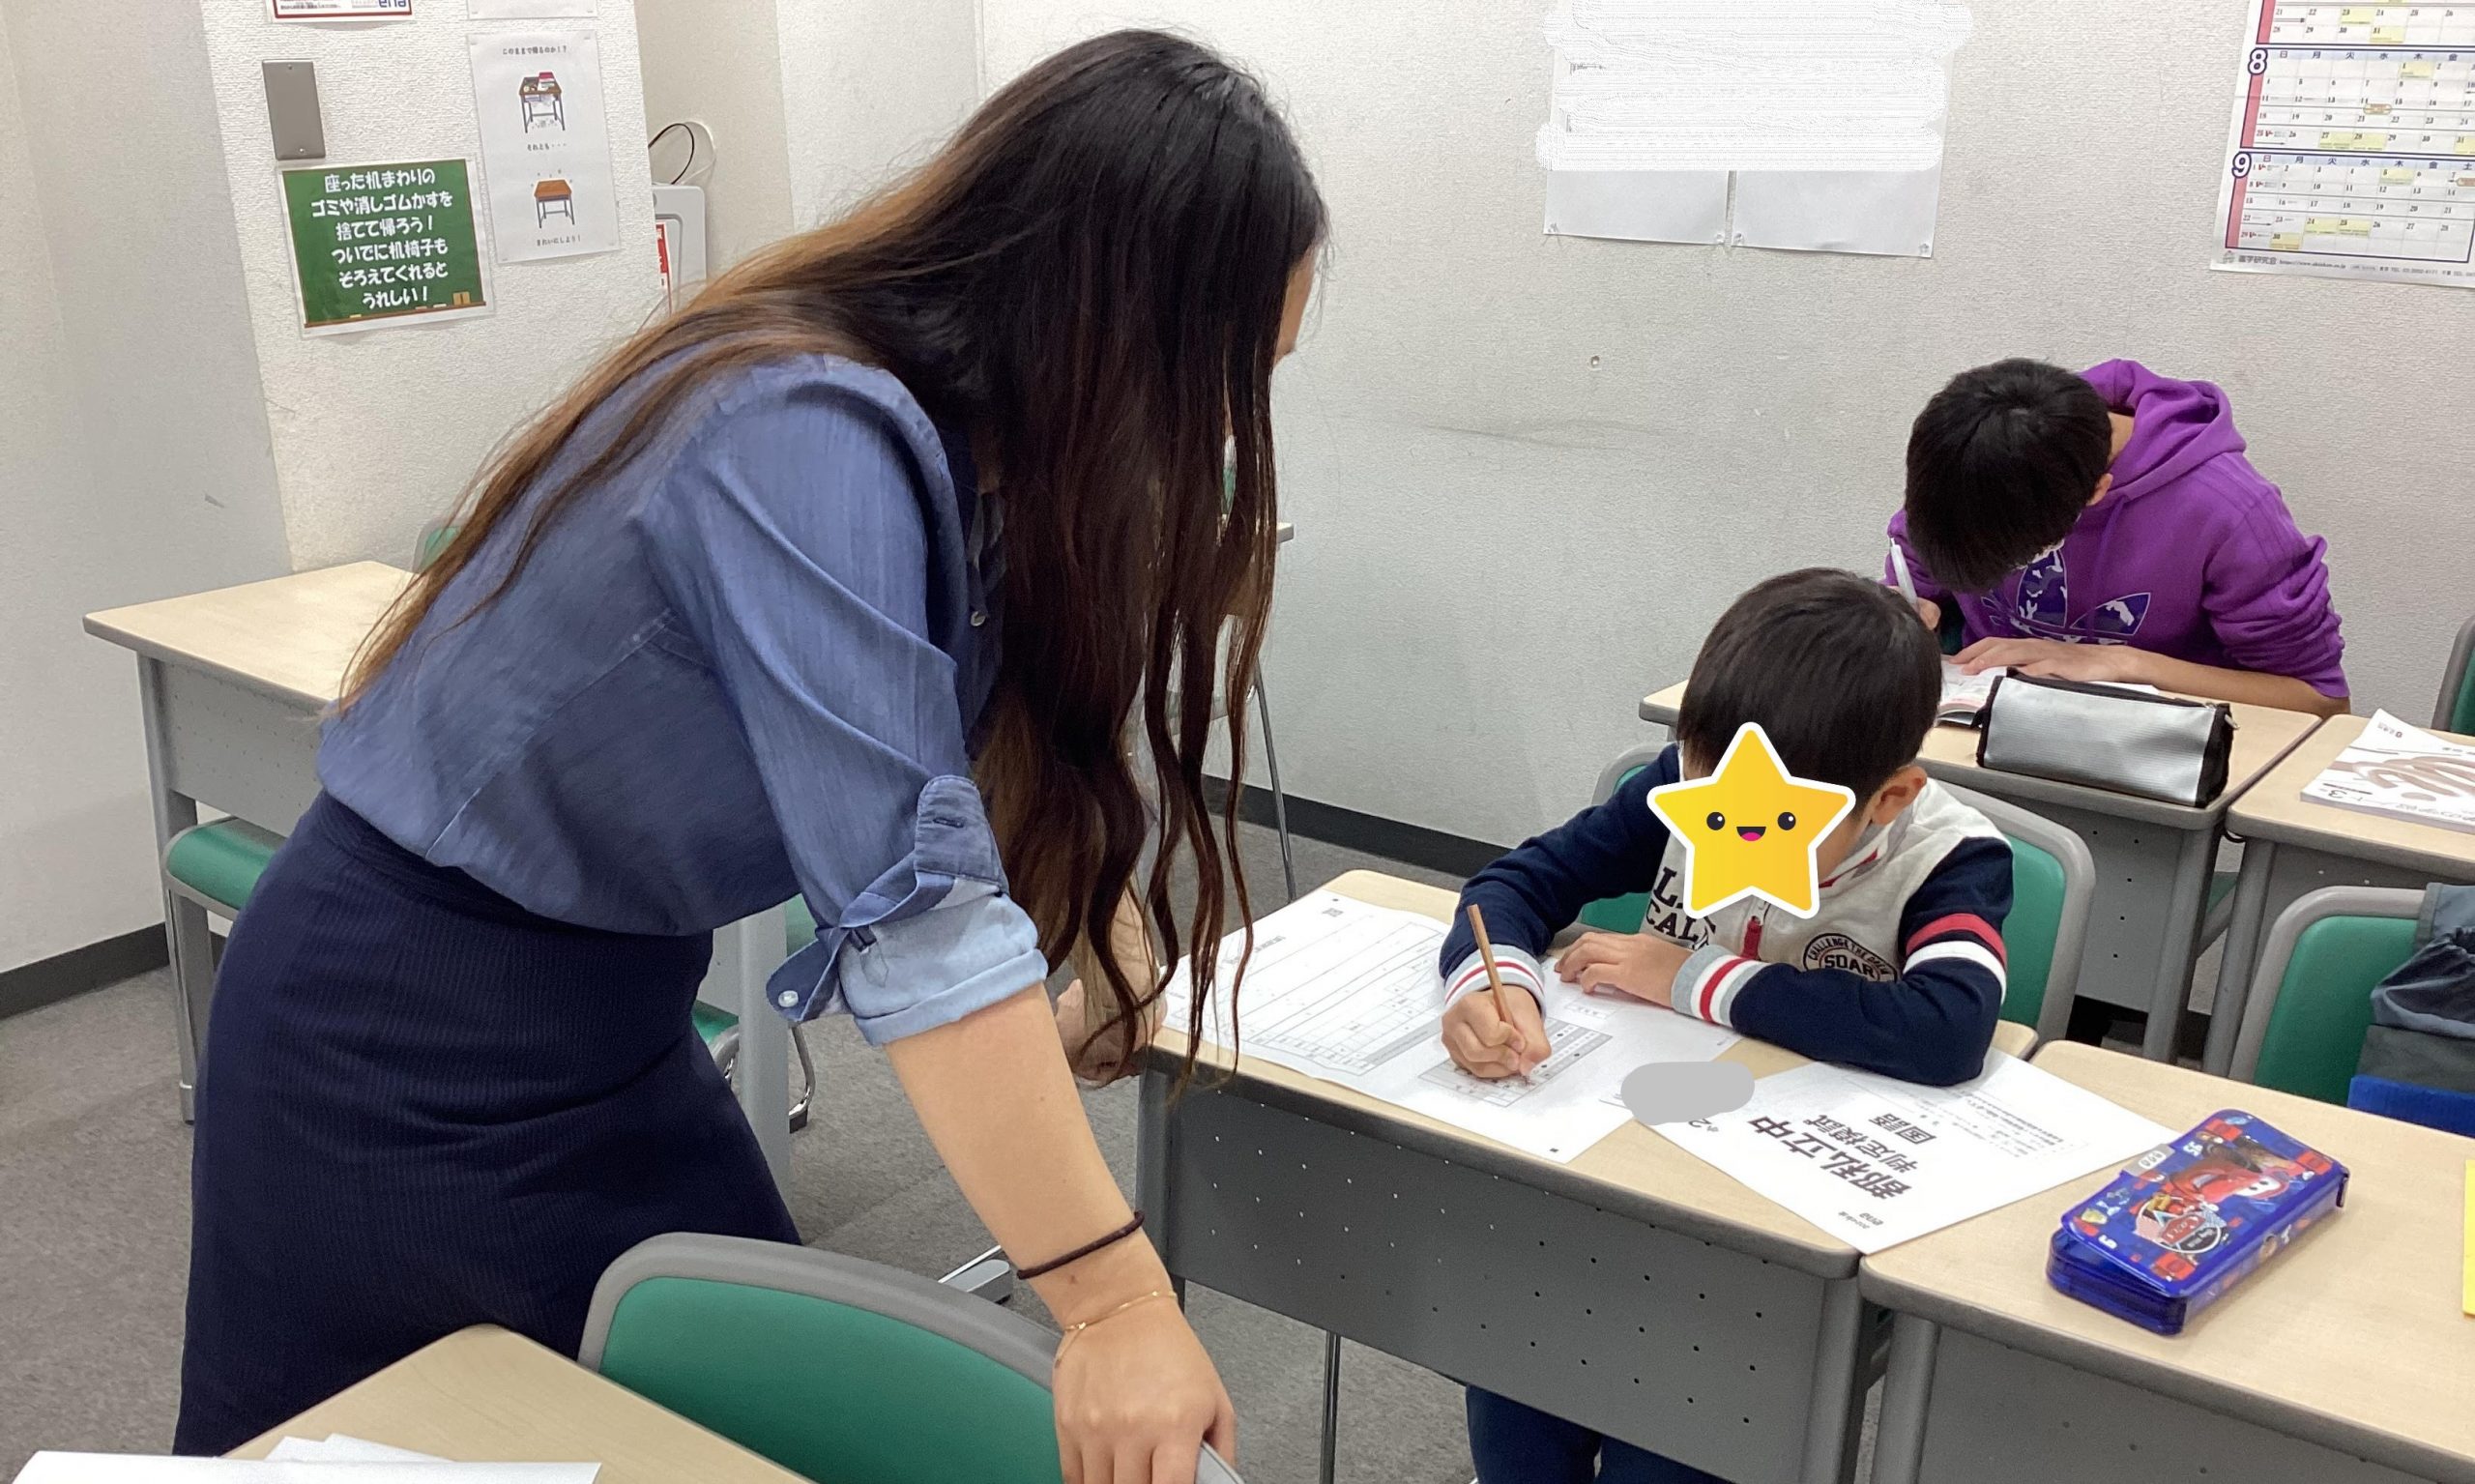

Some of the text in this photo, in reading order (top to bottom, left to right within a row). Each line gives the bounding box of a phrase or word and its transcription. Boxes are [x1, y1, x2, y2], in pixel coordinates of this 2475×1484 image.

[2247, 47, 2268, 74] 8
[2231, 152, 2252, 178] 9
[324, 168, 435, 193] 座った机まわりの
[310, 190, 453, 218] ゴミや消しゴムかすを
[335, 215, 433, 241] 捨てて帰ろう！
[331, 237, 449, 264] ついでに机椅子も
[338, 261, 449, 289] そろえてくれると
[362, 285, 428, 310] うれしい！
[1869, 1113, 1937, 1145] 国語
[1802, 1114, 1919, 1174] 判定模試
[1747, 1116, 1913, 1200] 都私立中
